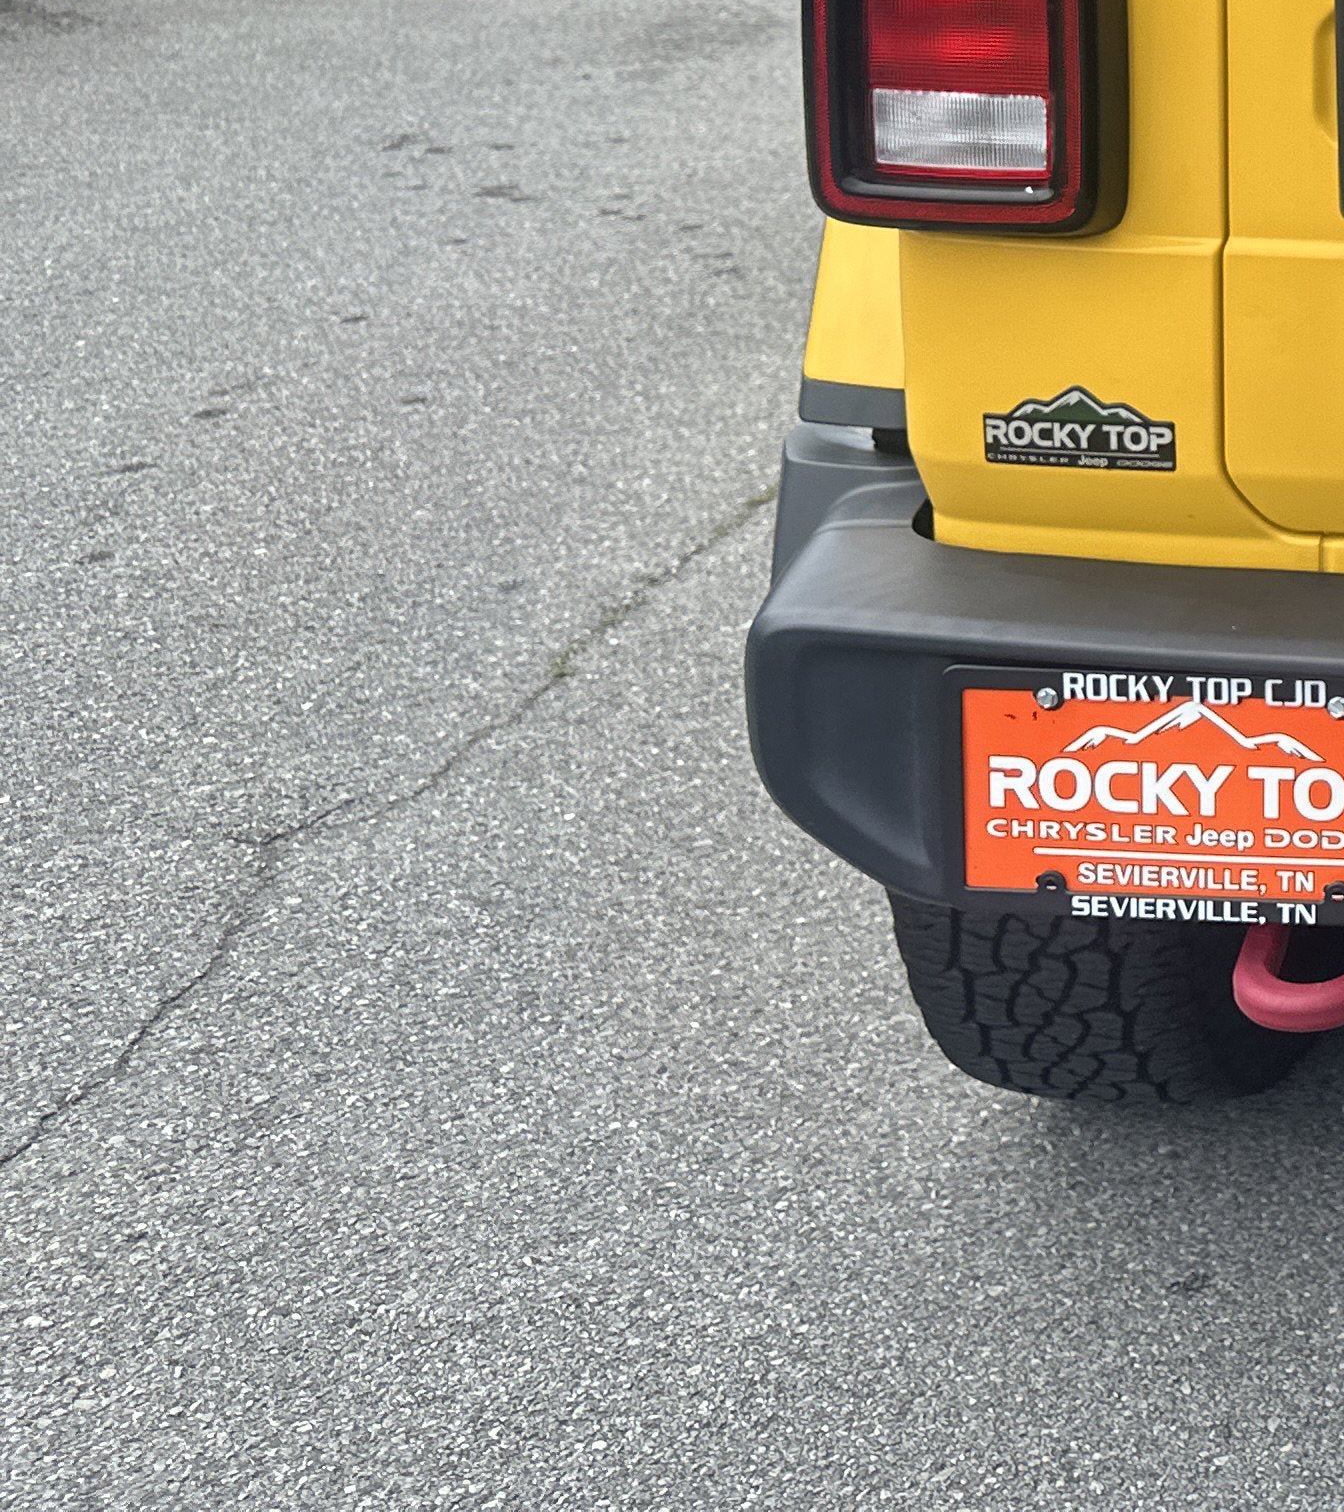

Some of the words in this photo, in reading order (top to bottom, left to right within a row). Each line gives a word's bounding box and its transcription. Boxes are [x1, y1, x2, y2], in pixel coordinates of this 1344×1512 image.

[985, 418, 1096, 449] ROCKY
[1102, 424, 1173, 453] TOP
[1077, 455, 1108, 467] Jeep
[1062, 672, 1174, 703] ROCKY
[1187, 677, 1252, 705] TOP
[1265, 679, 1326, 708] CJD
[988, 755, 1235, 817] ROCKY
[985, 818, 1177, 846] CHRYSLER
[1185, 824, 1255, 852] Jeep
[1078, 862, 1267, 895] SEVIERVILLE,
[1276, 870, 1315, 893] TN
[1072, 896, 1267, 925] SEVIERVILLE,
[1276, 902, 1317, 925] TN
